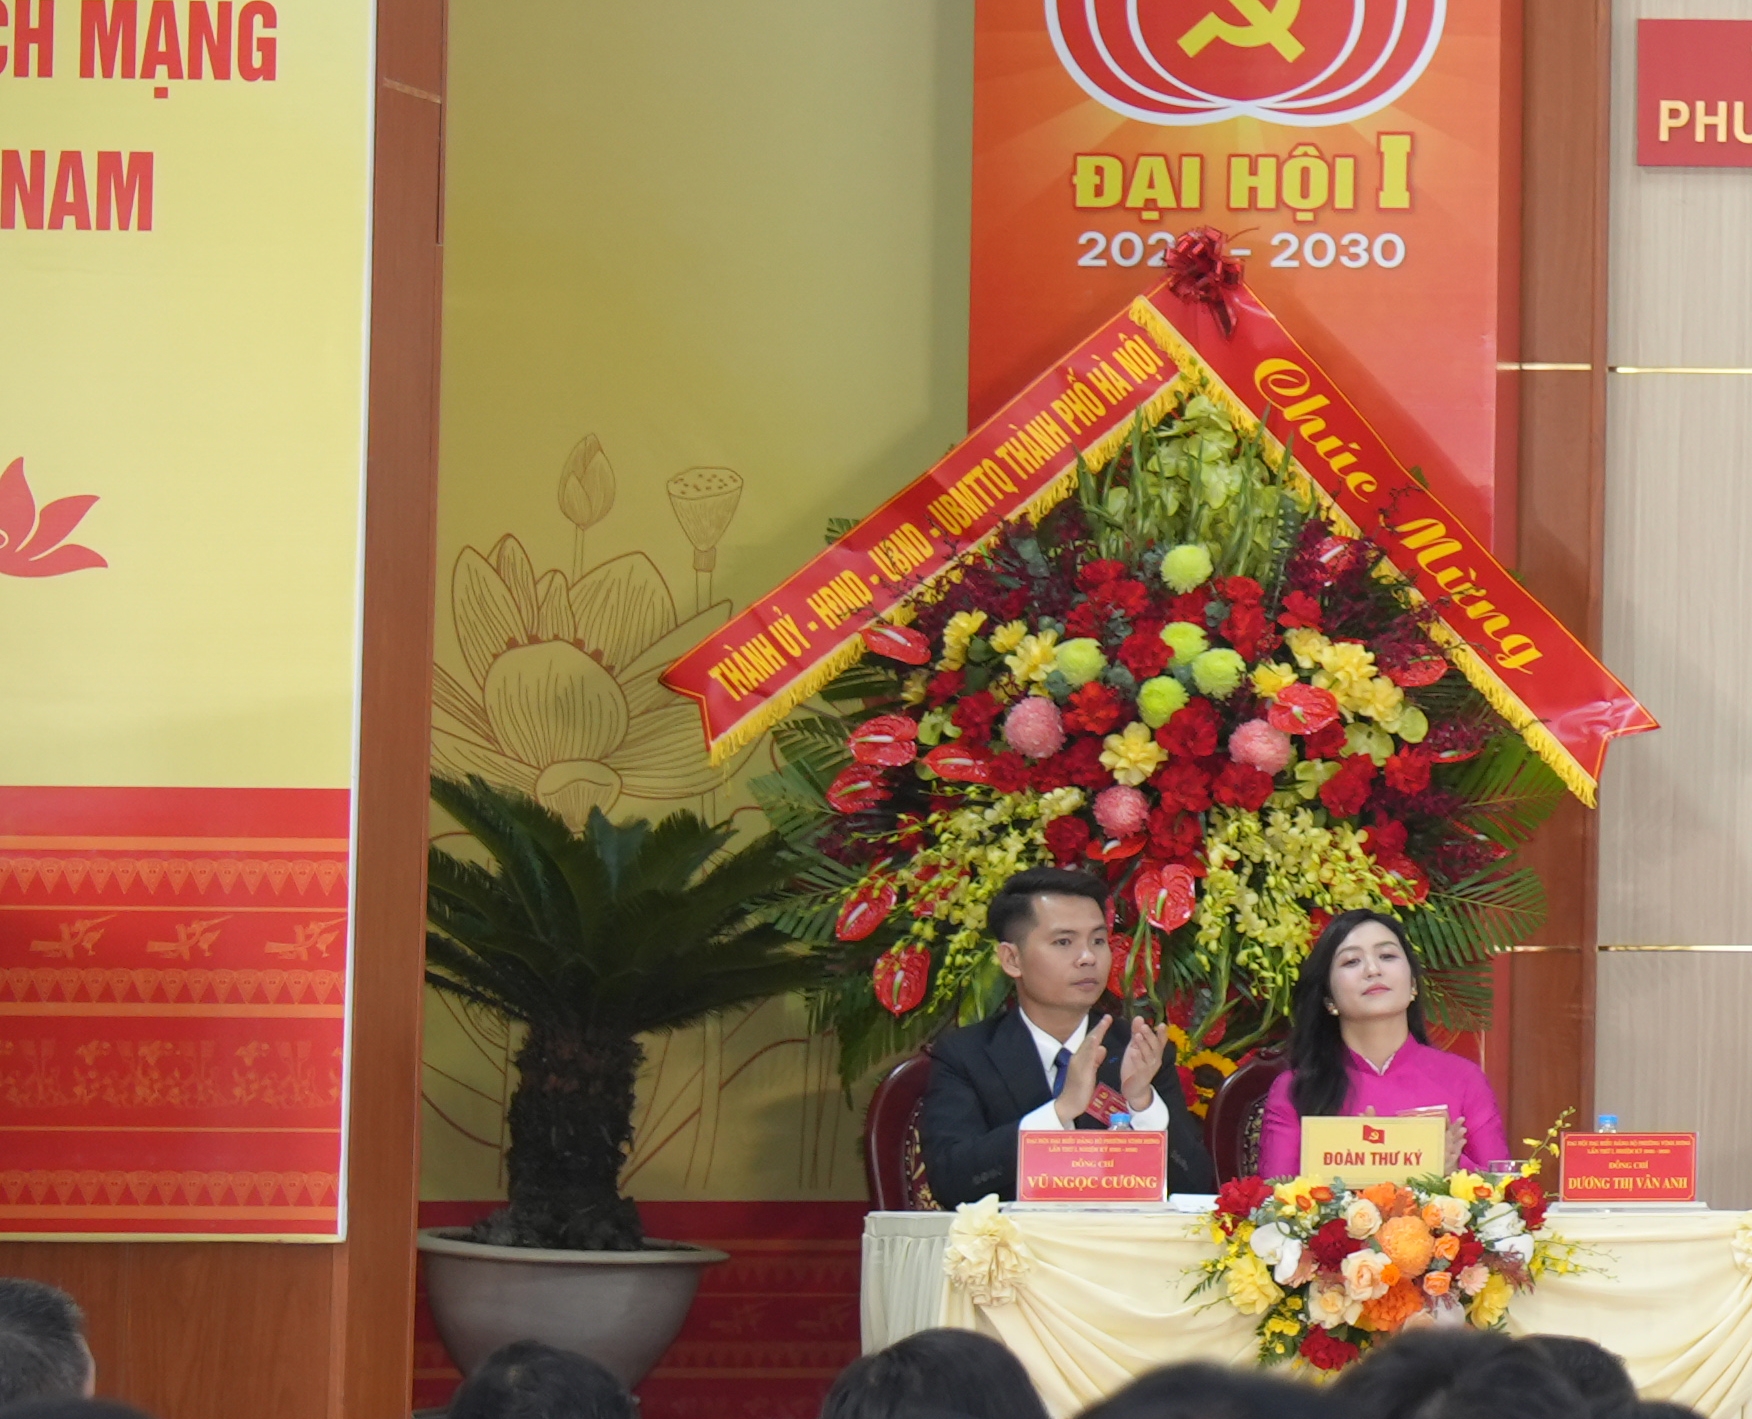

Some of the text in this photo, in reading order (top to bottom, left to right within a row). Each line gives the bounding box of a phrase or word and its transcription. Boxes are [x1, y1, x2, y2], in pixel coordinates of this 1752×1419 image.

[0, 149, 155, 231] NAM
[1072, 133, 1413, 222] ĐẠI HỘI I
[1077, 230, 1406, 270] 202 2030
[708, 633, 787, 701] THÀNH
[806, 569, 874, 630] HĐND
[868, 523, 934, 582] UBND
[929, 458, 1018, 535] UBMTTQ
[994, 410, 1072, 480] THÀNH
[1051, 367, 1106, 435] PHỐ
[1086, 354, 1134, 405] HÀ
[1111, 332, 1164, 385] NỘI
[1254, 357, 1543, 676] Chúc Mừng
[1027, 1174, 1049, 1188] VŨ
[1053, 1176, 1098, 1191] NGỌC
[1323, 1149, 1422, 1166] ĐOÀN THƯ KÝ
[1612, 1177, 1633, 1192] THỊ
[1662, 1177, 1688, 1189] ANH
